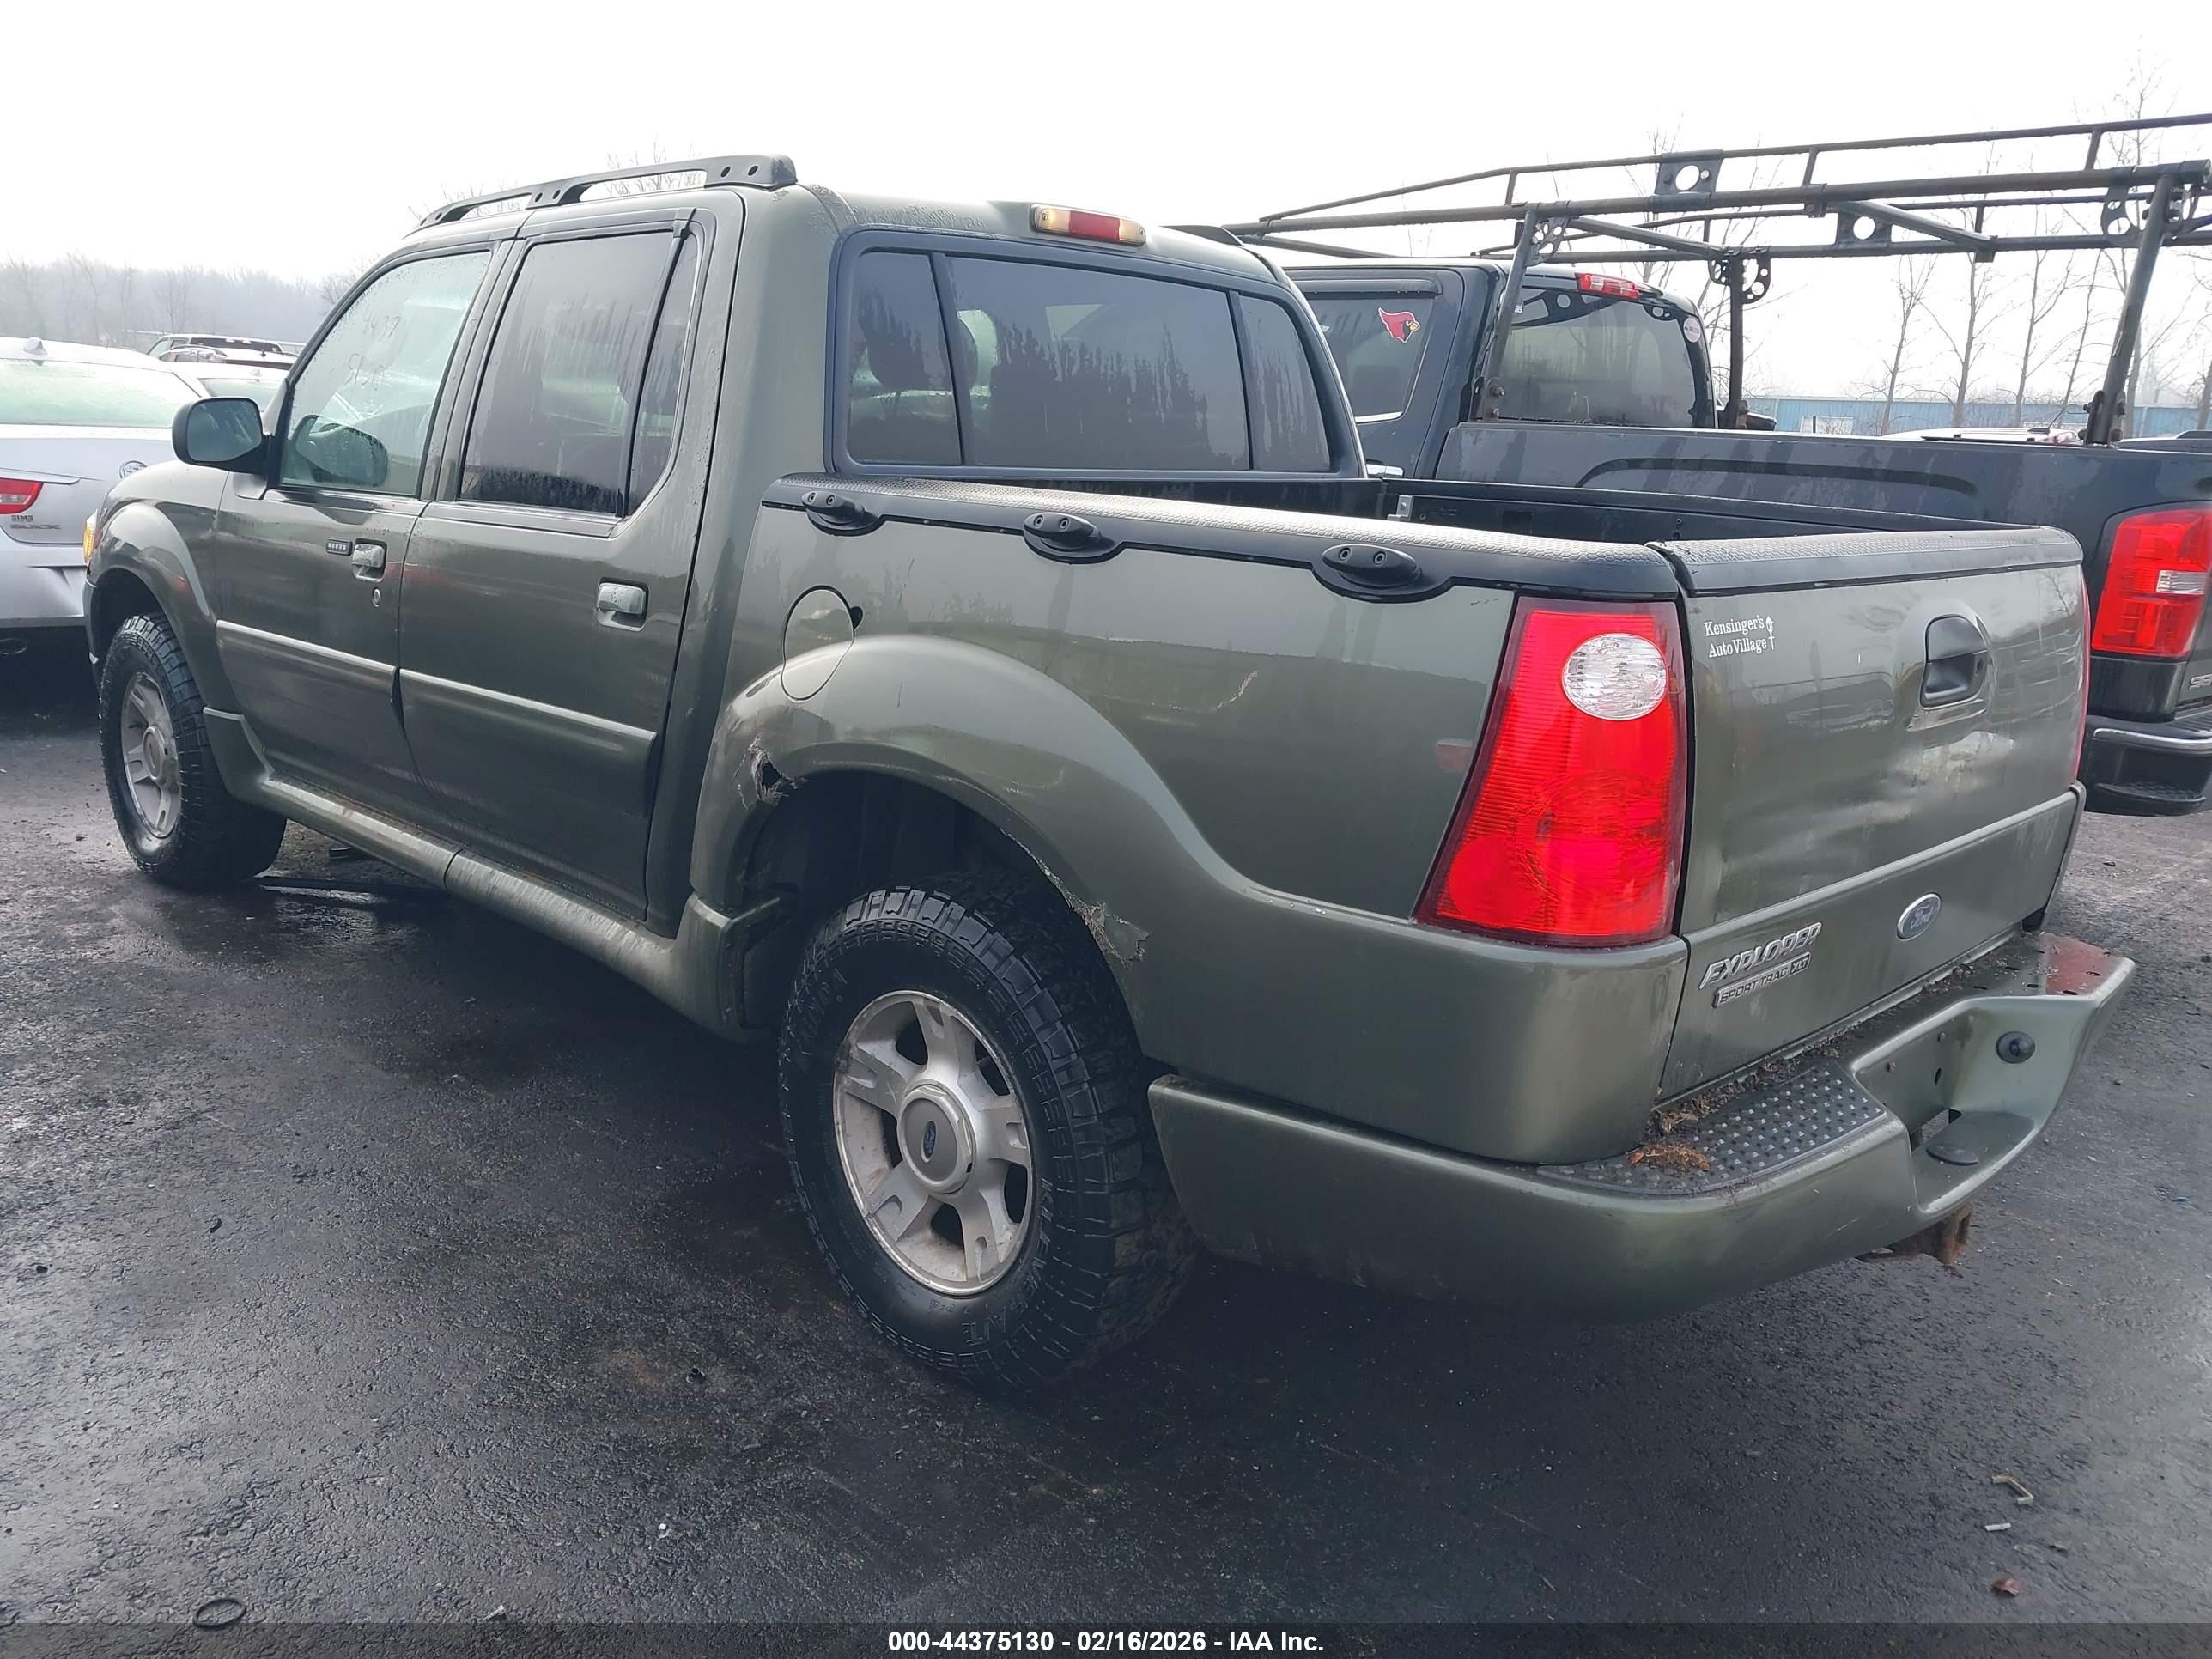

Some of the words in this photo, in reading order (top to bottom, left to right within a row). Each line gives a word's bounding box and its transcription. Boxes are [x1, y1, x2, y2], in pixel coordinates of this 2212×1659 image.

[1704, 614, 1765, 637] Kensinger's
[1698, 921, 1822, 990] EXPLORER
[1719, 979, 1759, 1004] SPORT
[1759, 967, 1789, 987] TRAC
[1791, 957, 1809, 973] XLT
